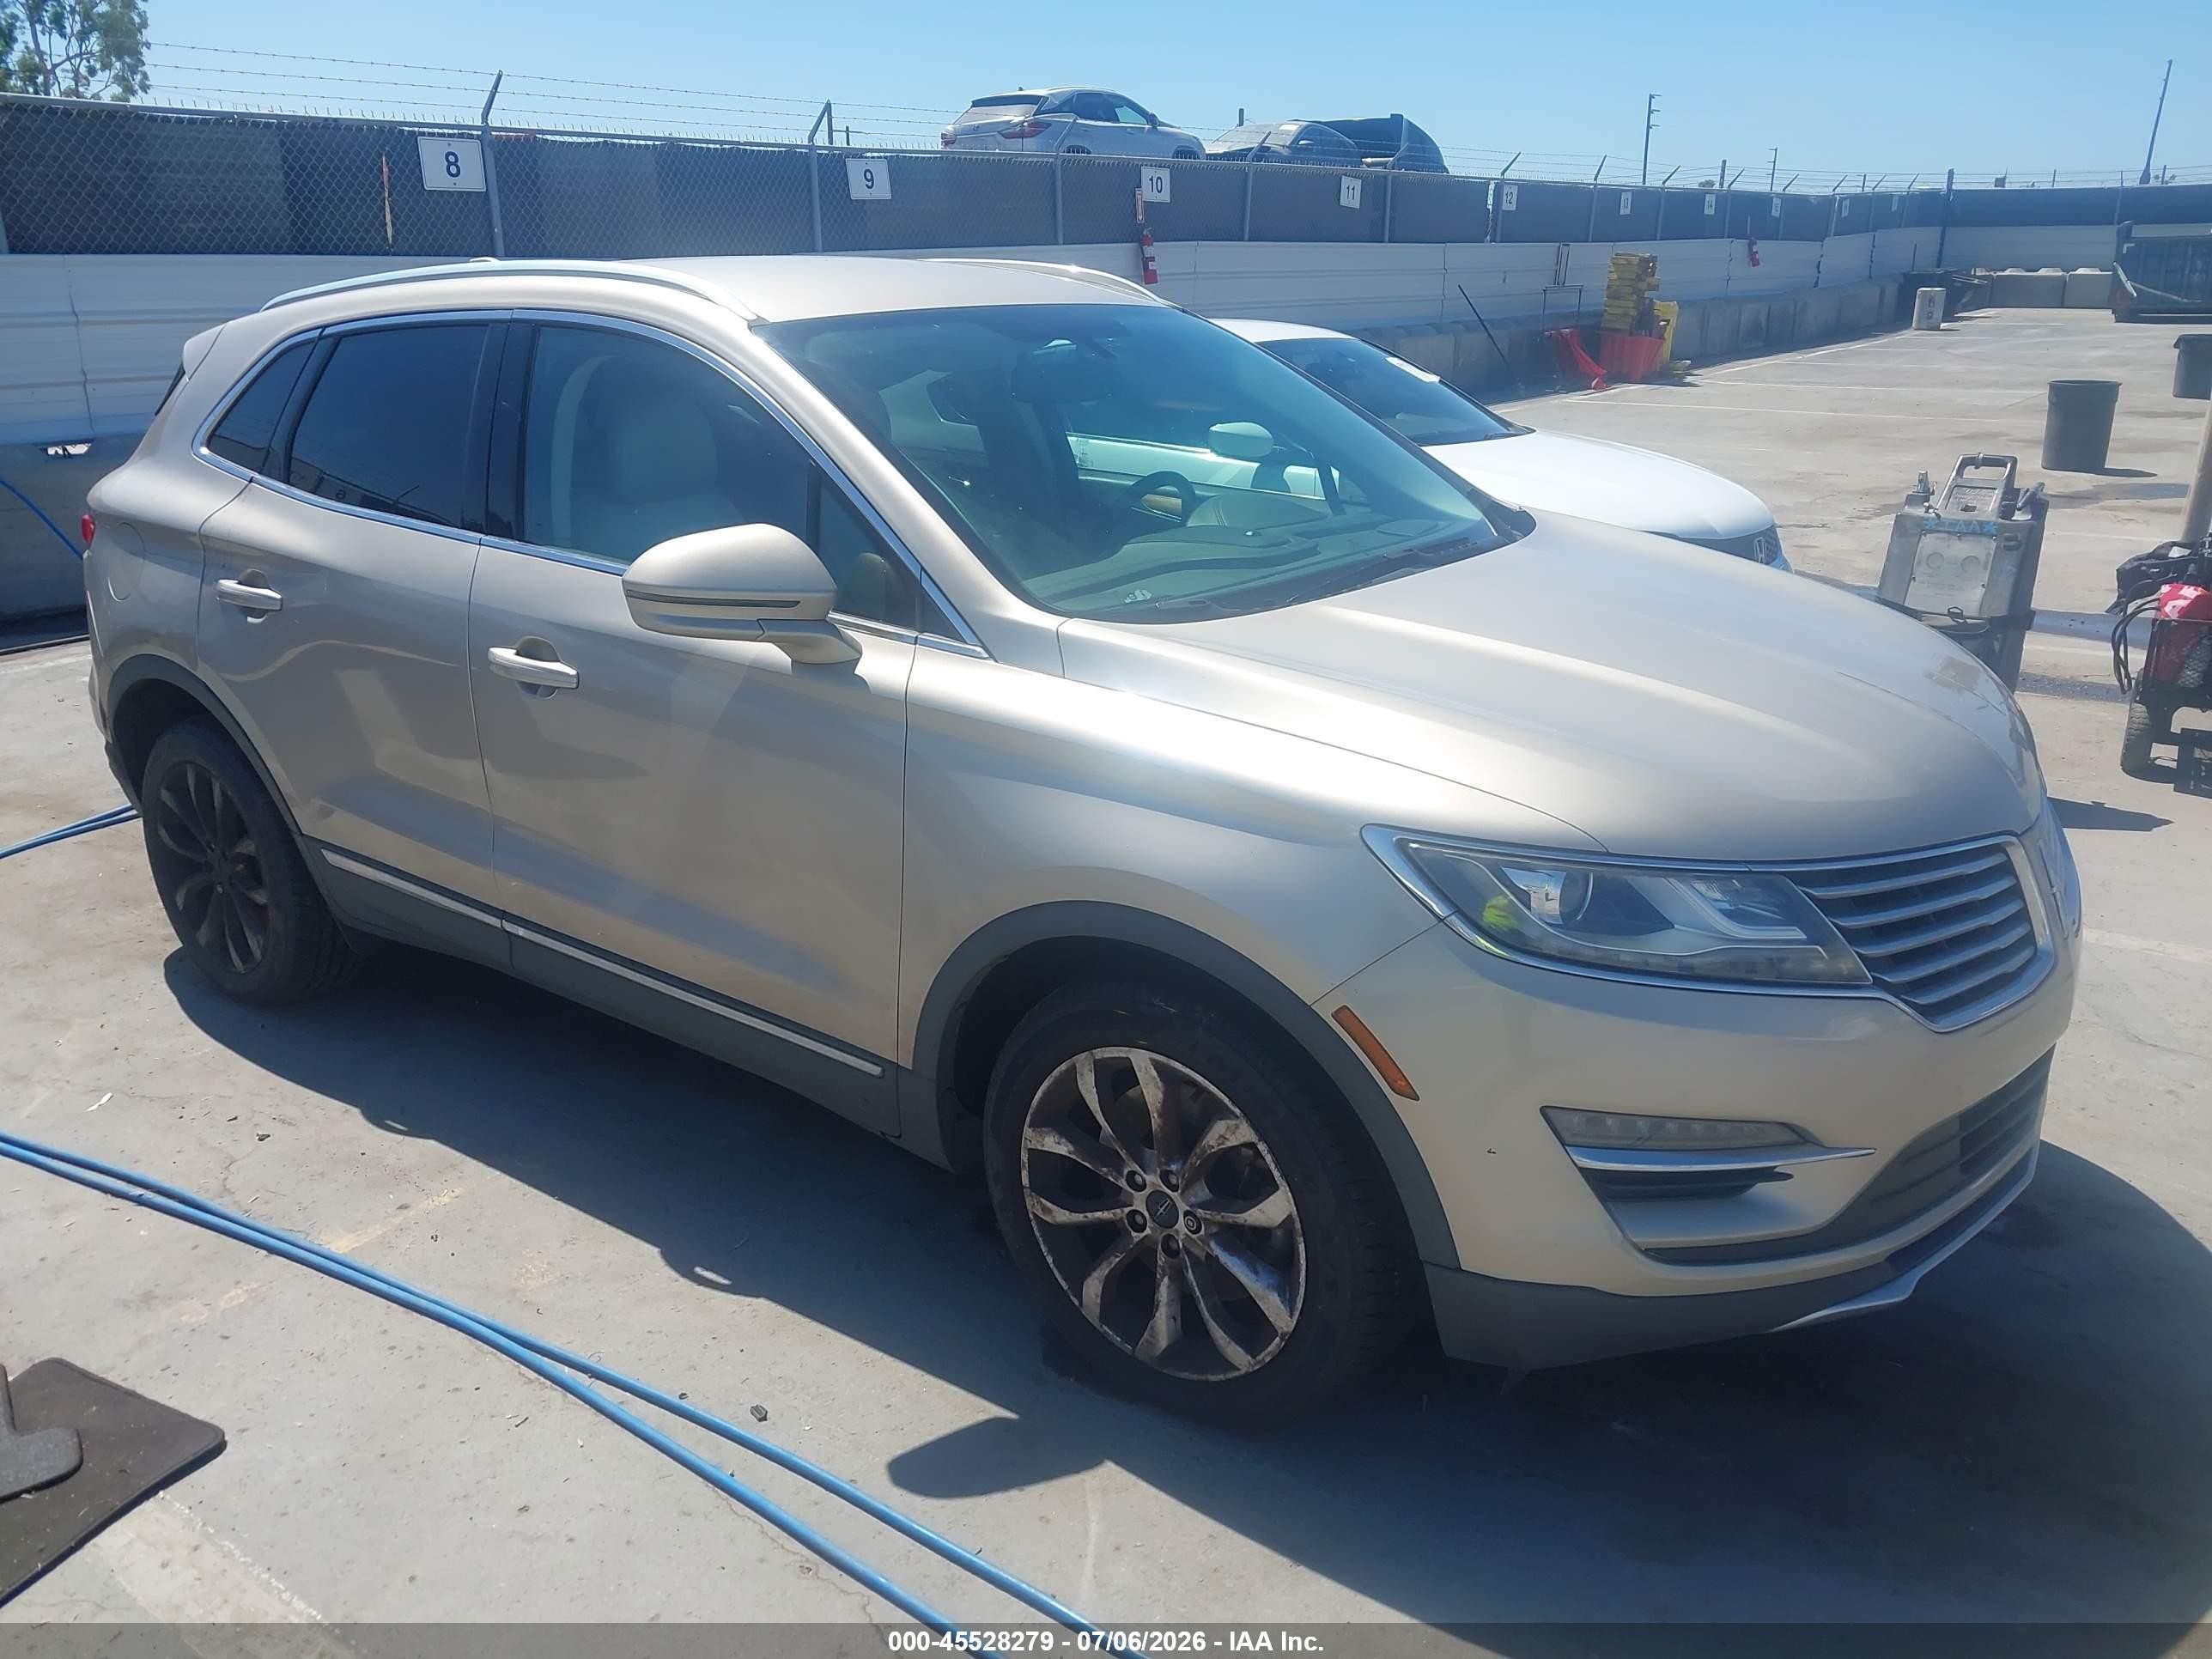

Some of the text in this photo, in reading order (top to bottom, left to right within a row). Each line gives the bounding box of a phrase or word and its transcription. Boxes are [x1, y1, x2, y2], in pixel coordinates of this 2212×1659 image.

[445, 151, 461, 178] 8
[863, 168, 875, 190] 9
[1148, 175, 1164, 194] 10
[1346, 185, 1356, 200] 11
[1505, 191, 1514, 204] 12
